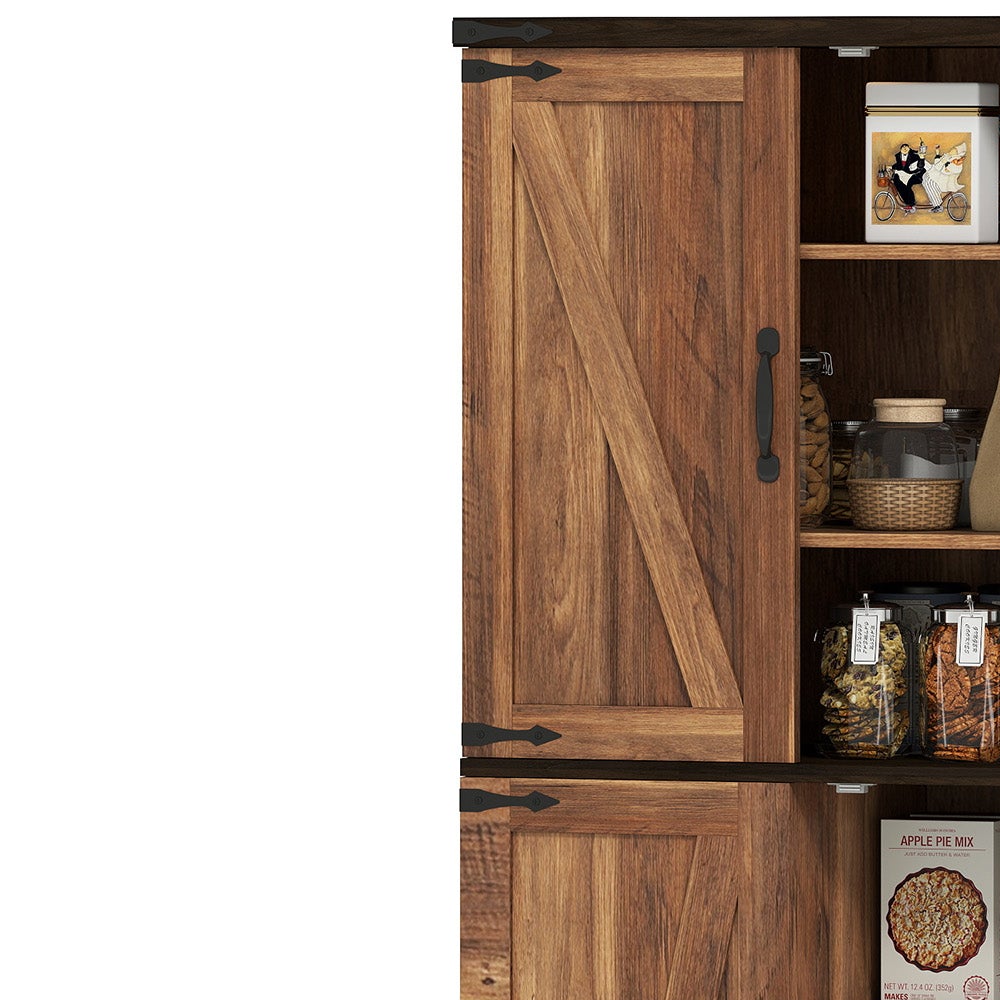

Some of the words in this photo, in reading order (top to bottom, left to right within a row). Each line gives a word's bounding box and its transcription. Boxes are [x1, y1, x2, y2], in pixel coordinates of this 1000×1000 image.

[900, 835, 933, 847] APPLE
[936, 836, 952, 847] PIE
[955, 836, 974, 848] MIX
[910, 983, 923, 991] 12.4
[884, 993, 909, 1000] MAKES
